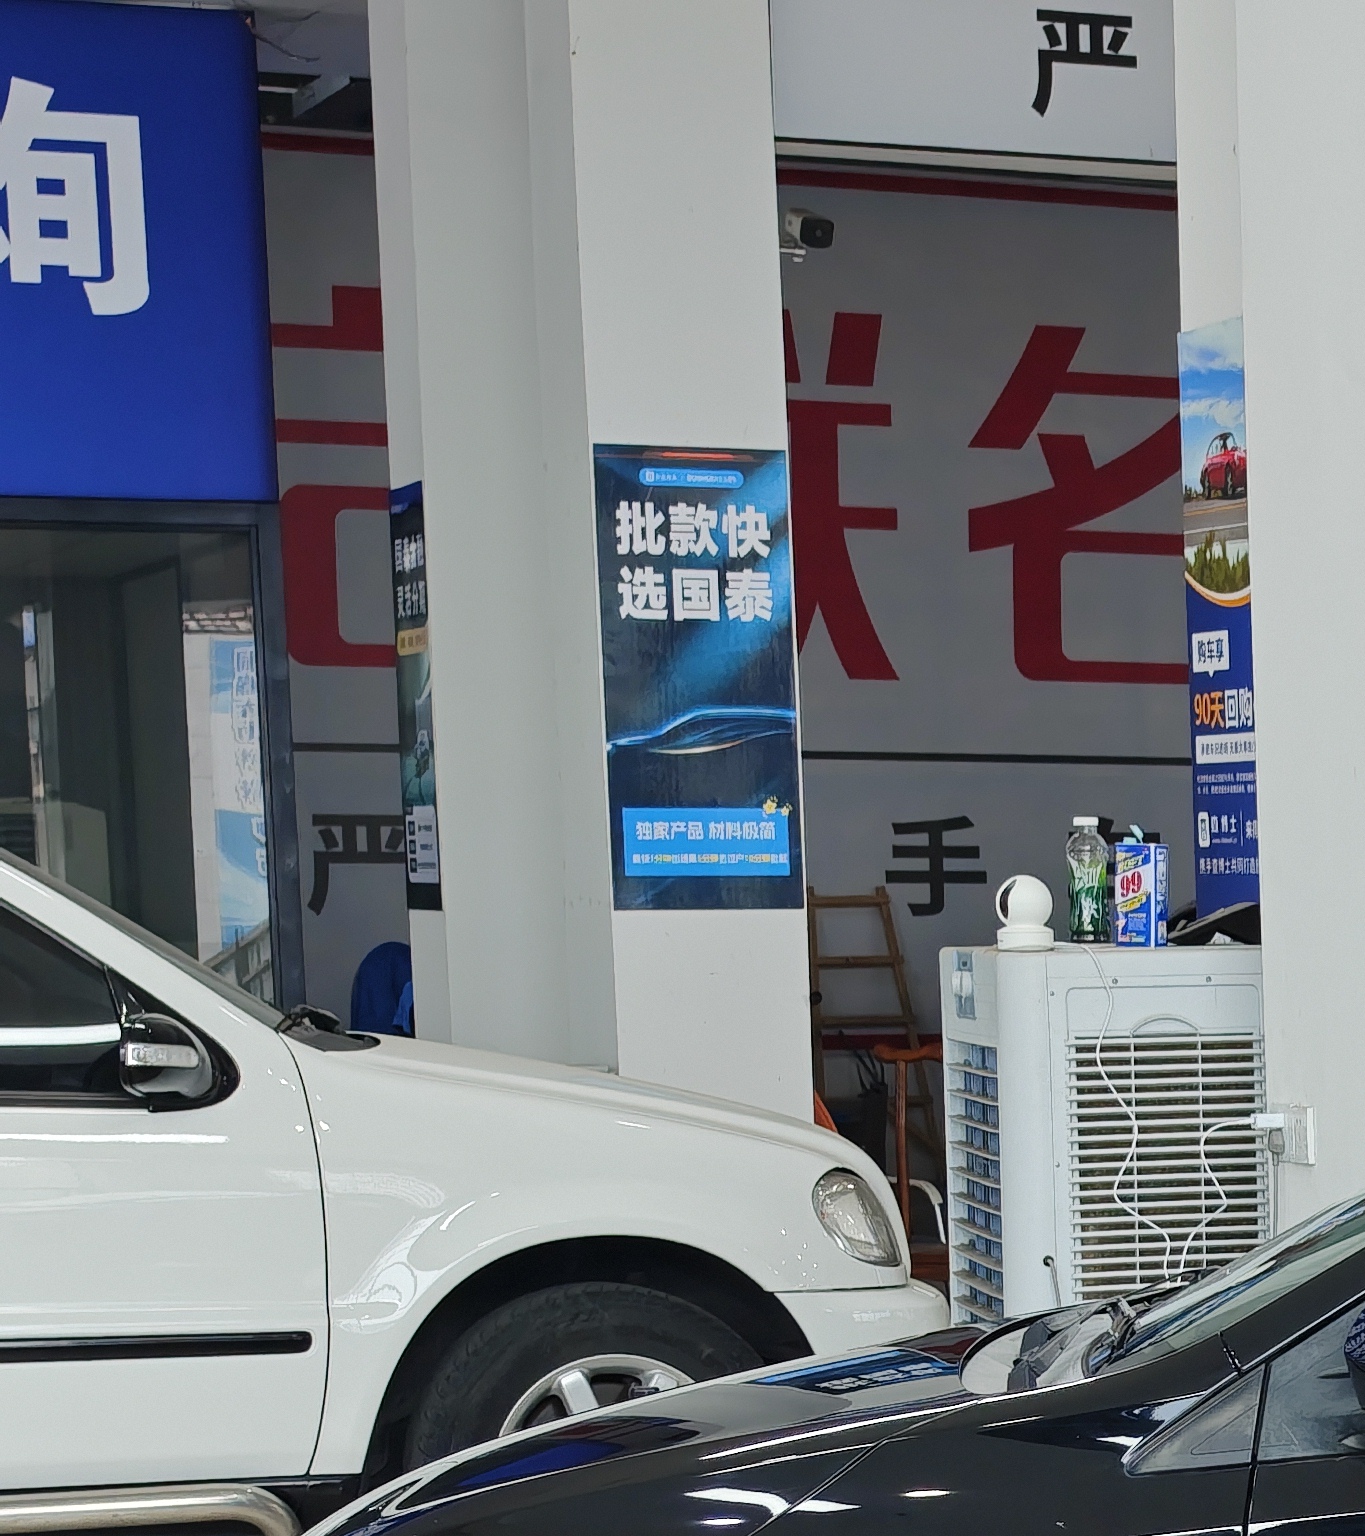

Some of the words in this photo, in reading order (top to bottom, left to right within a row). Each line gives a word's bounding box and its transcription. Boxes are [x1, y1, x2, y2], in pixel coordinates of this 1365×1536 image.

[1031, 8, 1138, 118] 严
[615, 500, 772, 558] 批款快
[617, 564, 774, 622] 选国泰
[636, 821, 704, 840] 独家产品
[884, 815, 988, 917] 手
